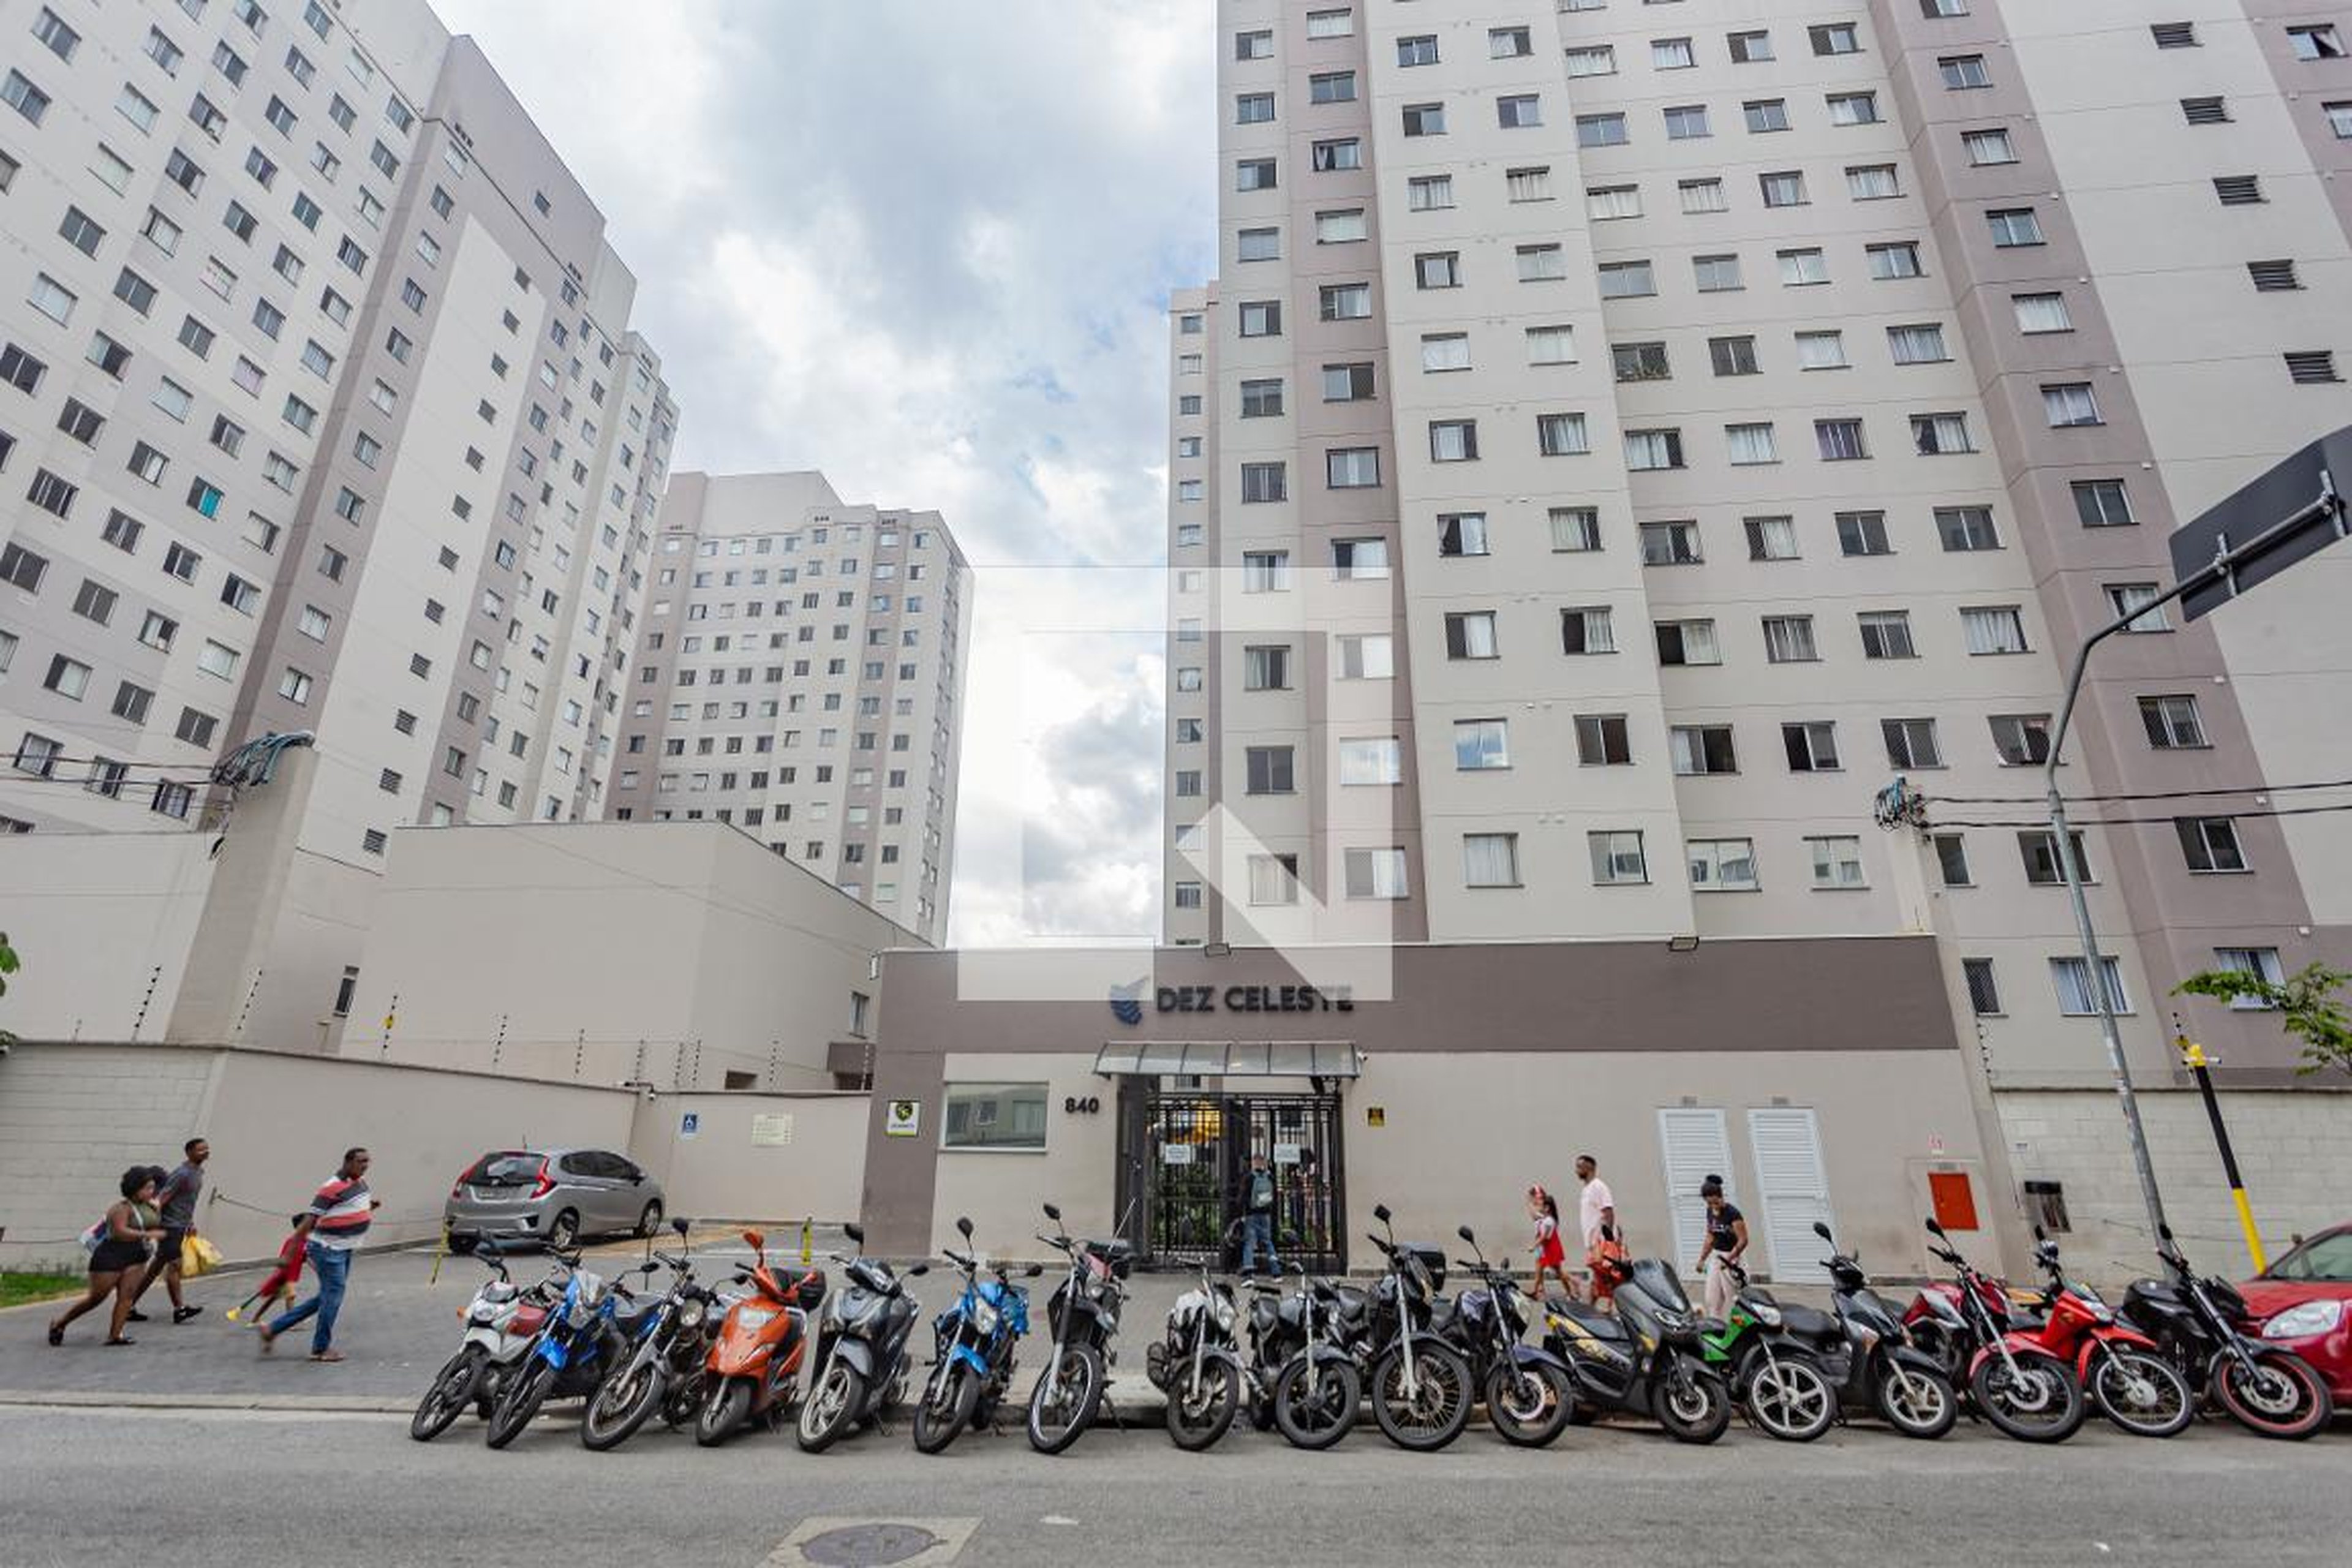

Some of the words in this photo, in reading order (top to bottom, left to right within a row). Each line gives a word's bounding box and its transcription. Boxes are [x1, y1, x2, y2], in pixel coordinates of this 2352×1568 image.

[1156, 985, 1215, 1012] DEZ
[1224, 985, 1354, 1012] CELESTE
[1065, 1096, 1099, 1114] 840
